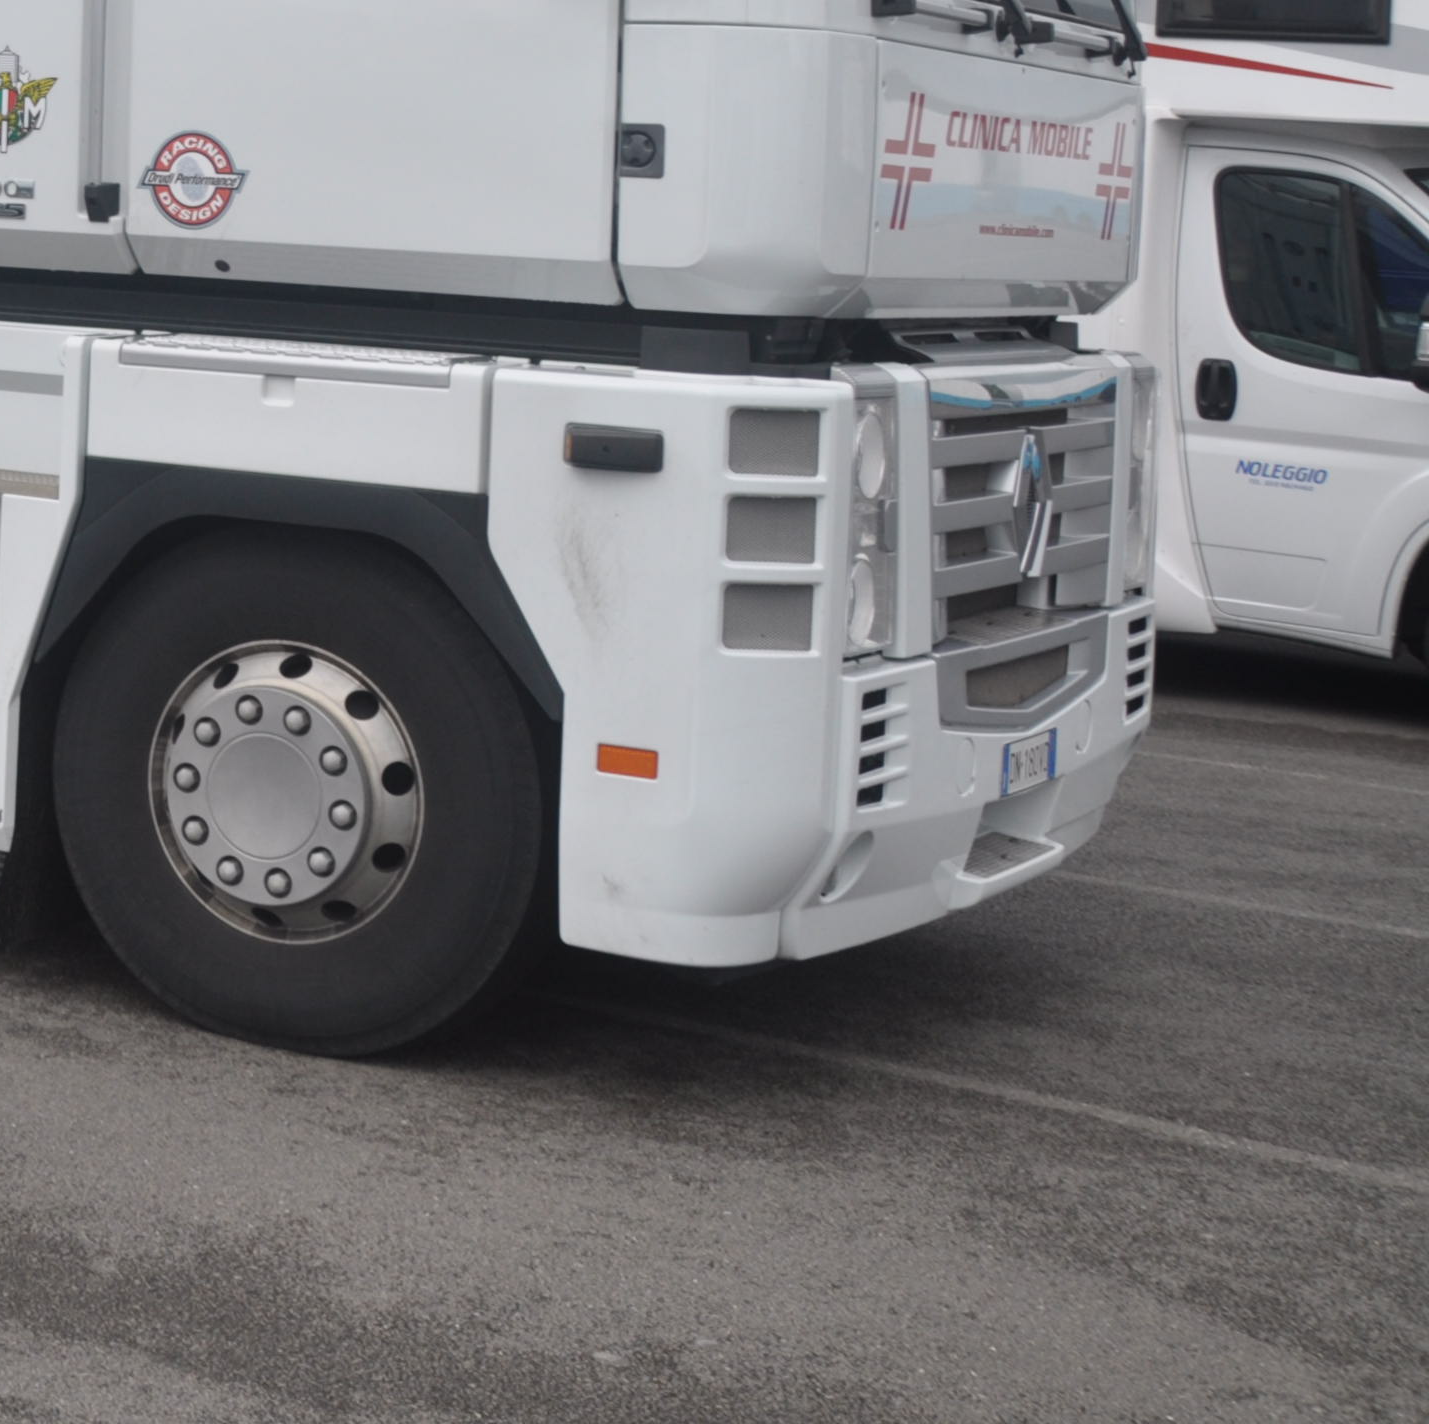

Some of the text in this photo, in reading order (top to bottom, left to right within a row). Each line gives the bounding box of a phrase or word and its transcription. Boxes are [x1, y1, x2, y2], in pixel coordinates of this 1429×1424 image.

[946, 110, 1094, 160] CLINICA MOBILE
[160, 136, 228, 168] RACING
[159, 192, 224, 221] DESIGN
[1235, 459, 1329, 485] NOLEGGIO
